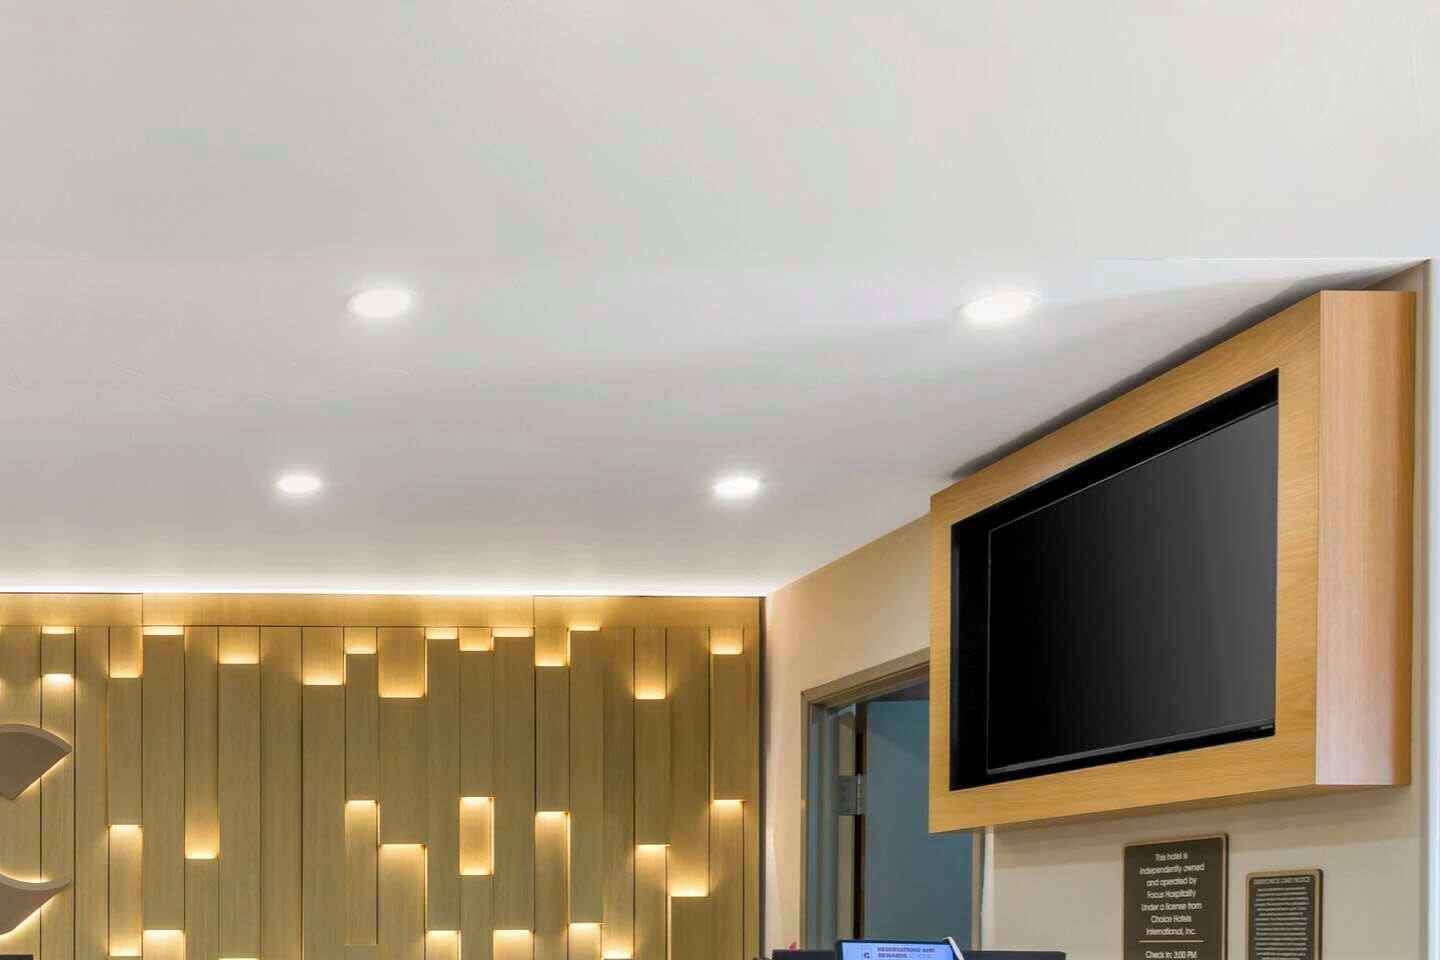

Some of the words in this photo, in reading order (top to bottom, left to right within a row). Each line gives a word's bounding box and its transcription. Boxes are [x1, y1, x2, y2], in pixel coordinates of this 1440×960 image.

[1155, 853, 1166, 861] This
[1167, 852, 1182, 860] hotel
[1183, 852, 1189, 860] is
[1139, 865, 1182, 875] independently
[1183, 862, 1205, 872] owned
[1146, 879, 1159, 887] and
[1160, 877, 1187, 887] operated
[1188, 877, 1197, 886] by
[1187, 902, 1203, 910] from
[1150, 915, 1172, 923] Choice
[1173, 914, 1192, 923] Hotels
[1145, 950, 1165, 959] Check
[1187, 950, 1198, 959] PM
